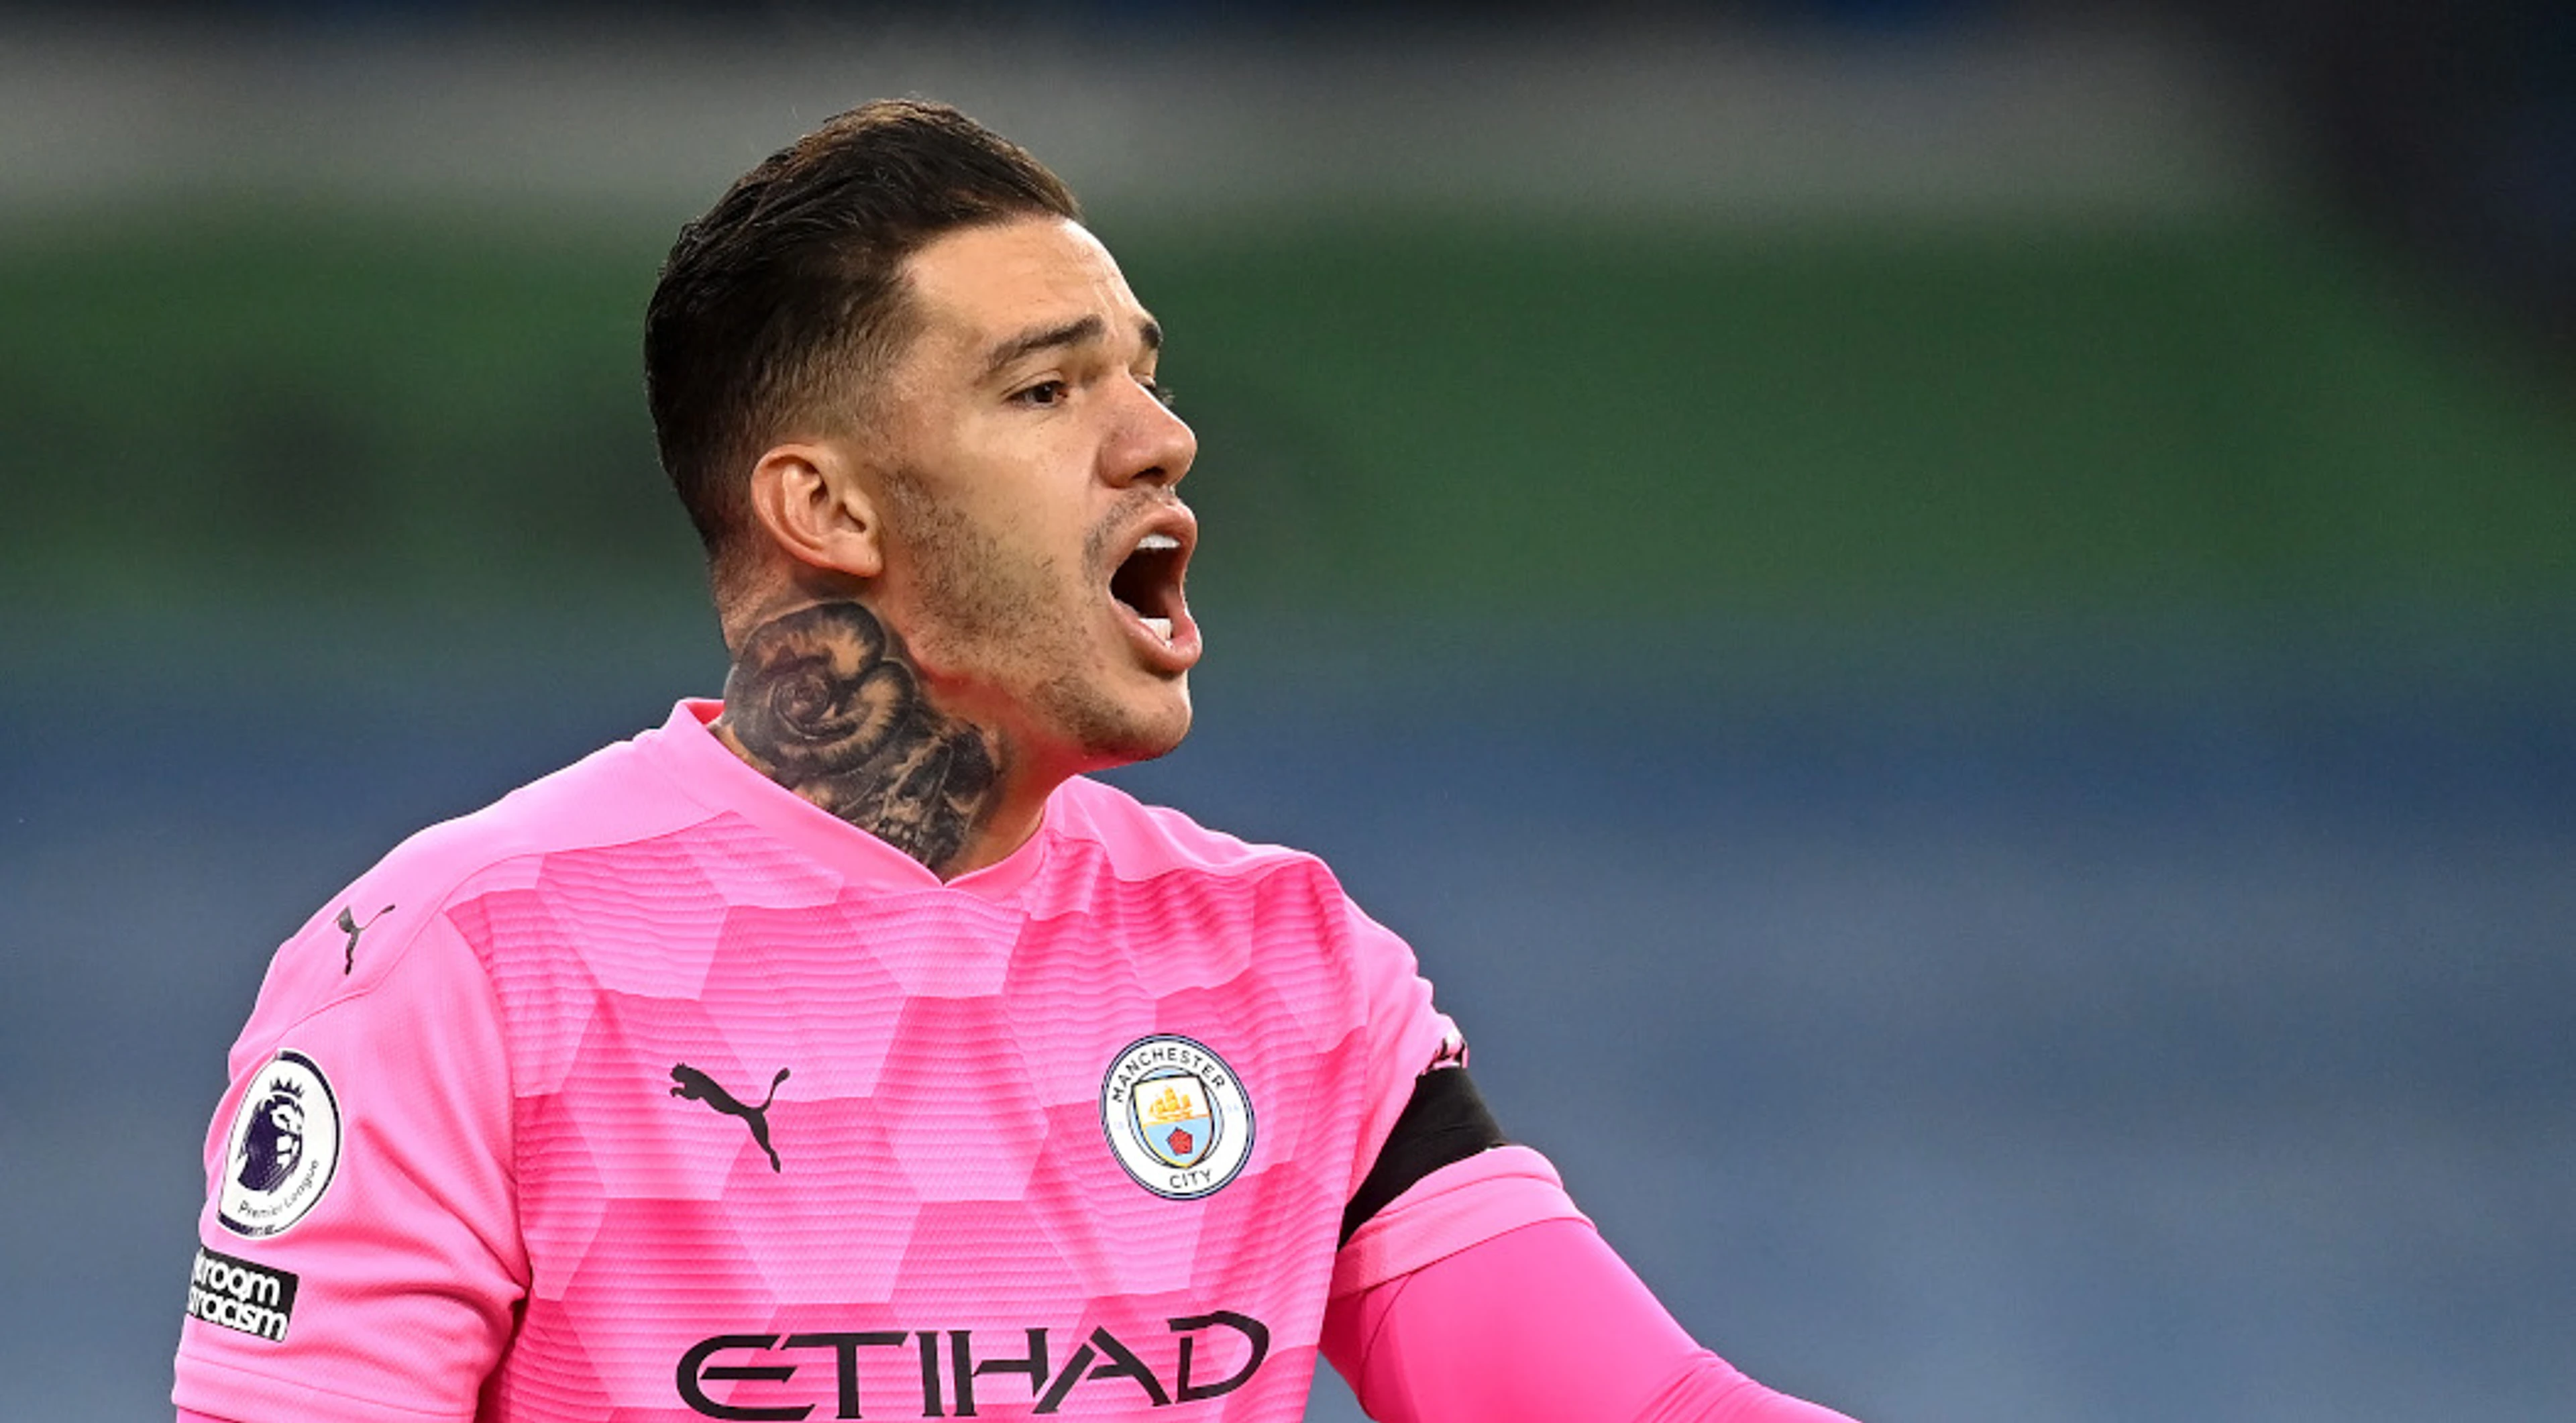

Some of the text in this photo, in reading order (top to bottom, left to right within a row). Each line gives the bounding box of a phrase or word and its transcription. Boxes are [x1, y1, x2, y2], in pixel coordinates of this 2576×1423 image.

[1112, 1047, 1226, 1103] MANCHESTER
[284, 1159, 319, 1208] League
[1169, 1168, 1212, 1189] CITY
[201, 1256, 280, 1306] room
[675, 1310, 1271, 1422] ETIHAD
